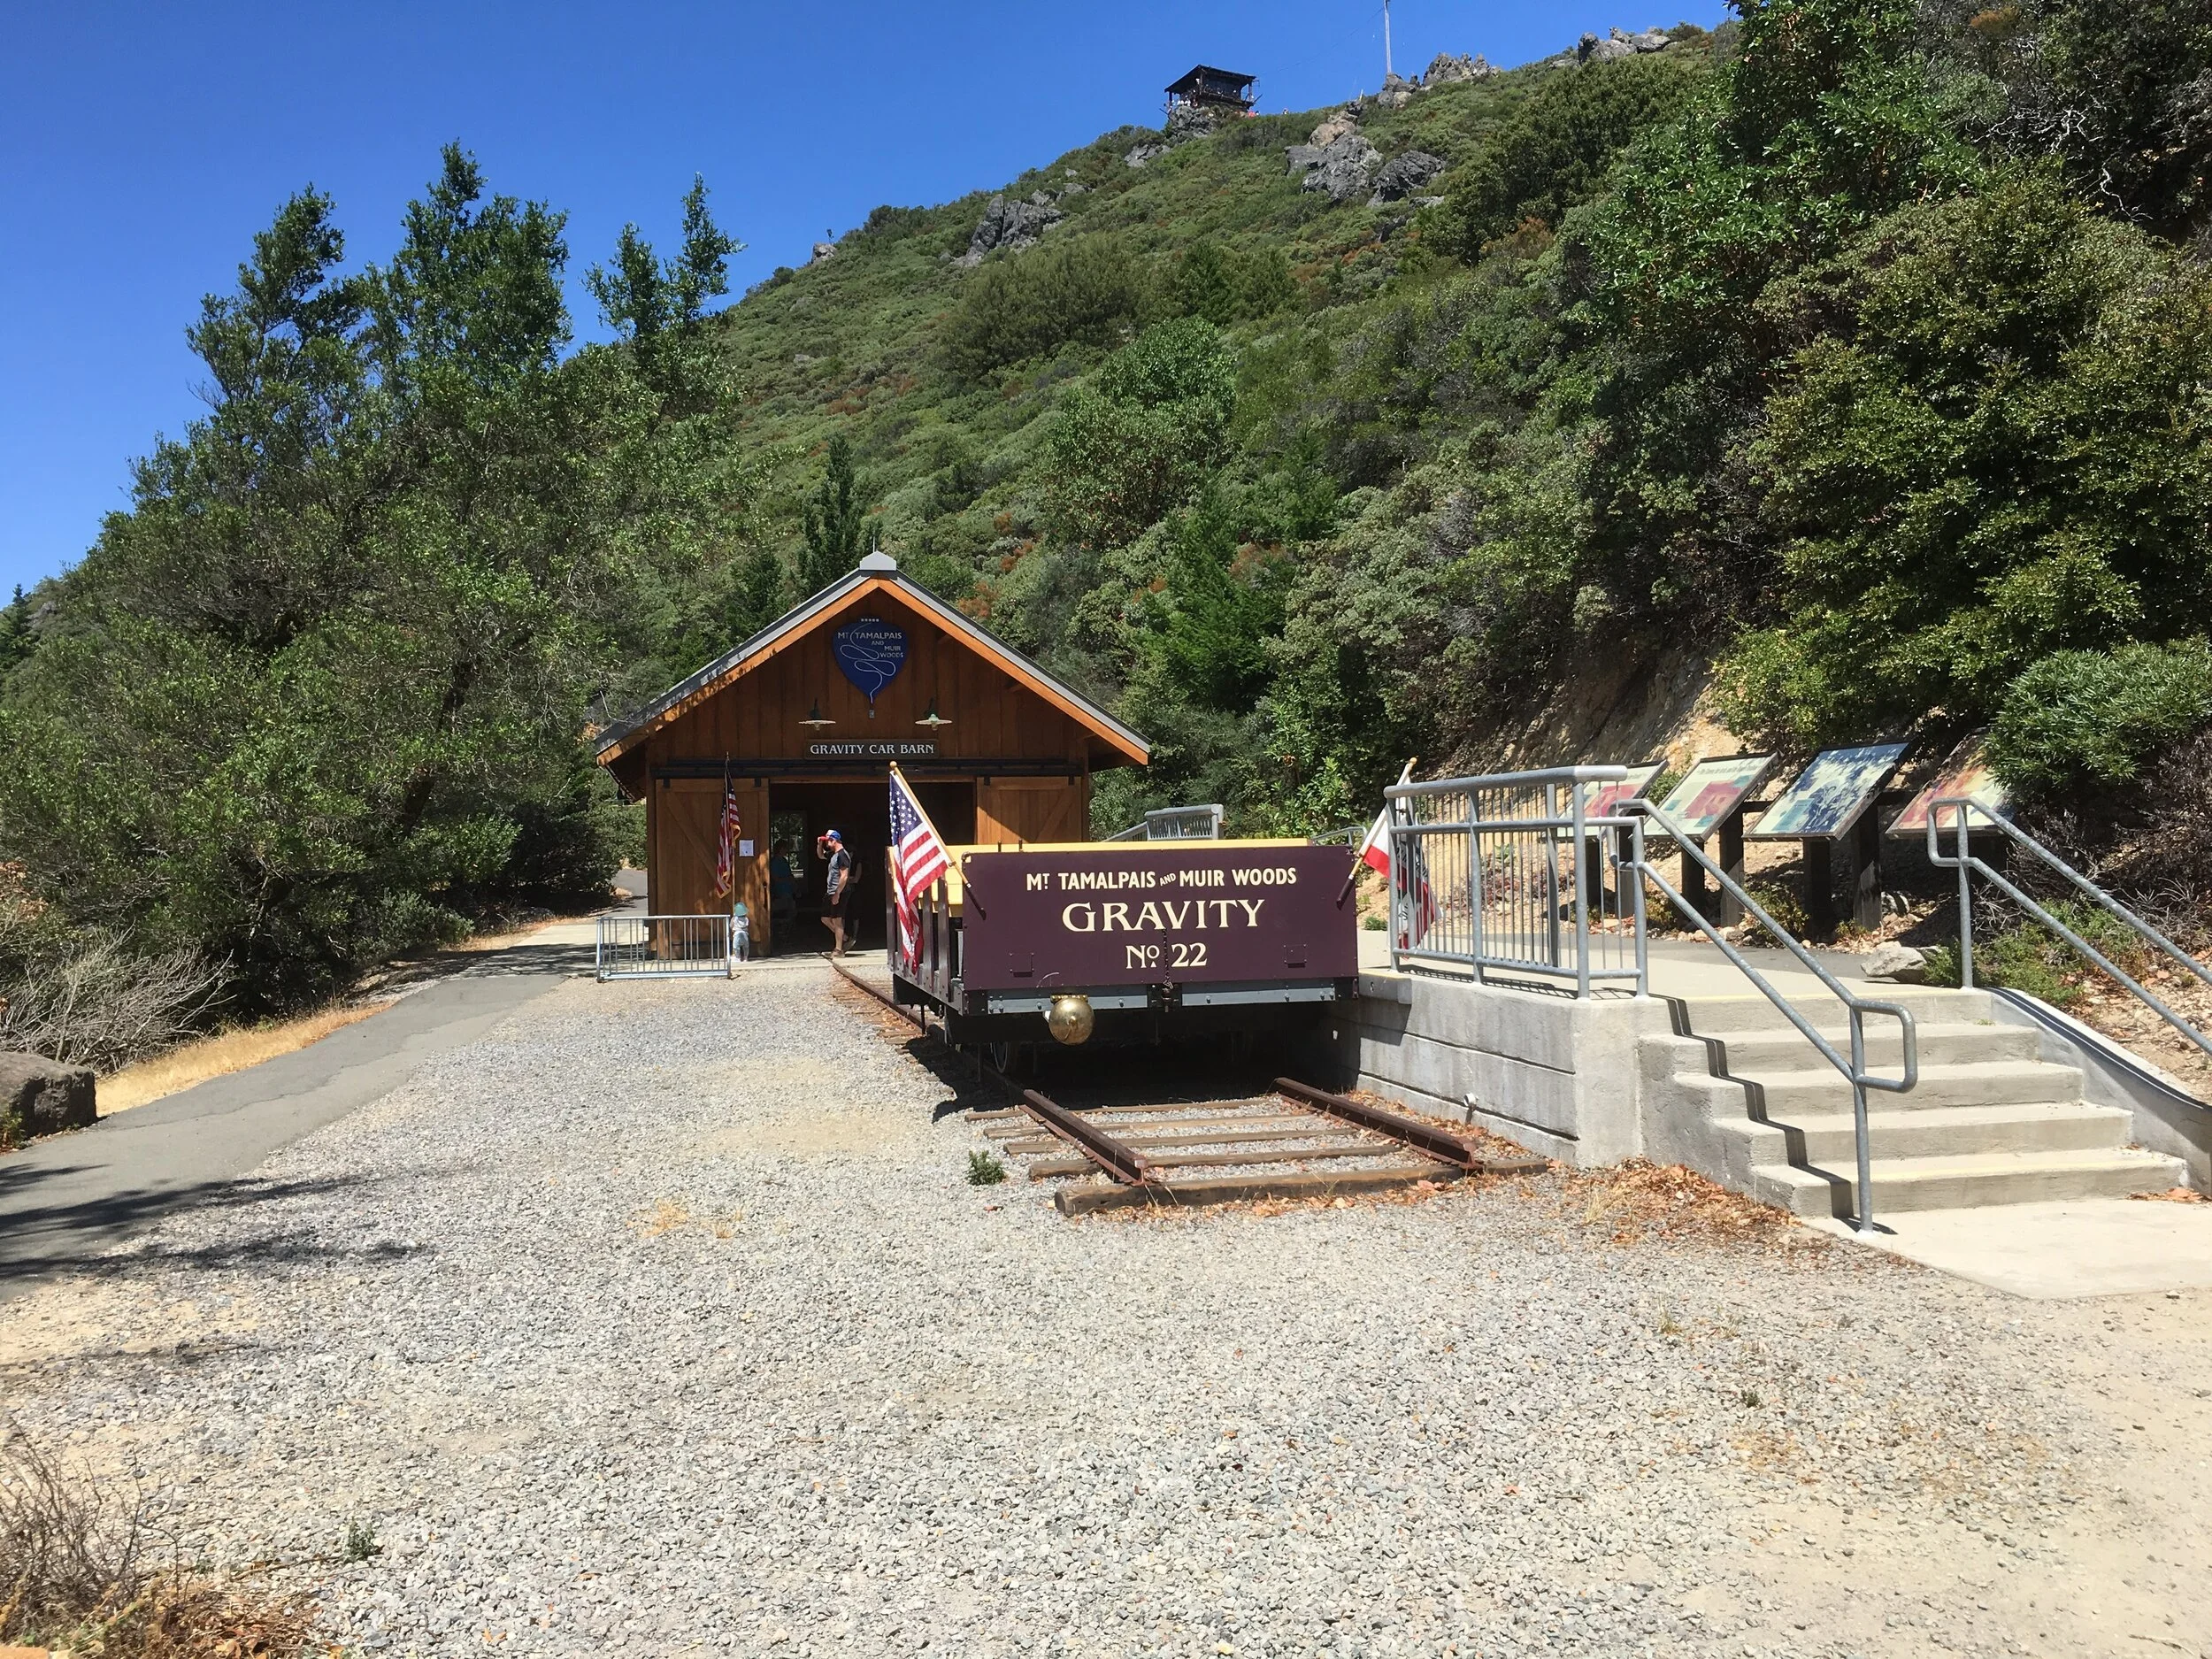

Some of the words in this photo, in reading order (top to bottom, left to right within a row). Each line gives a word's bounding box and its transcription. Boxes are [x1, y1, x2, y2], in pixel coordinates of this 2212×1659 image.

[810, 744, 864, 755] GRAVITY
[869, 744, 895, 754] CAR
[900, 744, 934, 754] BARN
[1058, 871, 1156, 890] TAMALPAIS
[1159, 872, 1177, 887] AND
[1179, 870, 1225, 887] MUIR
[1232, 867, 1297, 886] WOODS
[1063, 899, 1265, 932] GRAVITY
[1171, 942, 1208, 968] 22
